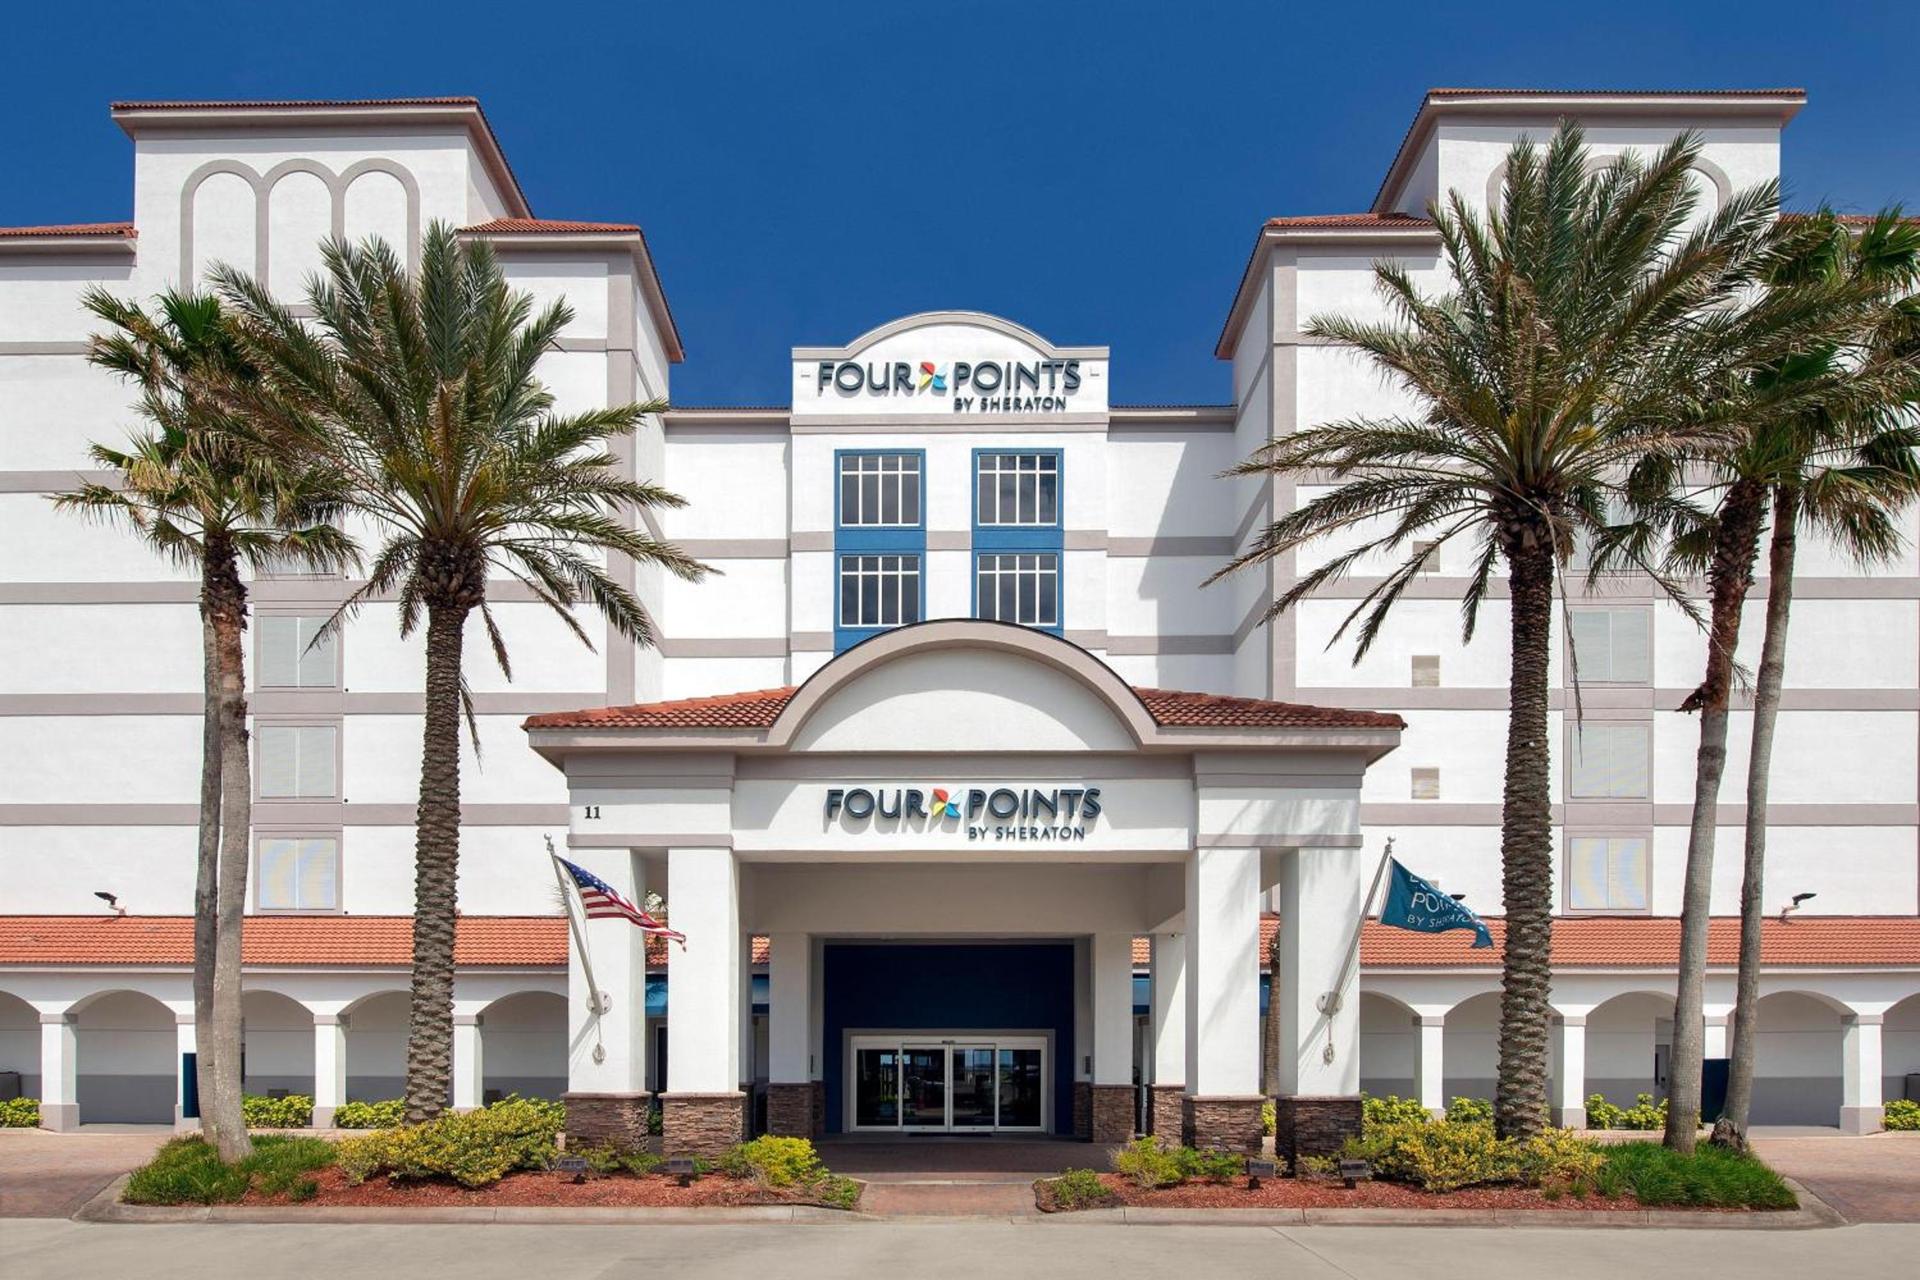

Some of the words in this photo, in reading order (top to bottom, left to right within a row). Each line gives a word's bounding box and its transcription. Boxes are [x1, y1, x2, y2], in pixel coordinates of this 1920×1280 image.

[818, 361, 915, 391] FOUR
[953, 360, 1081, 391] POINTS
[953, 397, 973, 411] BY
[980, 397, 1067, 411] SHERATON
[827, 788, 928, 819] FOUR
[968, 788, 1102, 819] POINTS
[584, 805, 601, 820] 11
[968, 826, 989, 840] BY
[996, 826, 1085, 840] SHERATON
[1407, 914, 1425, 926] BY
